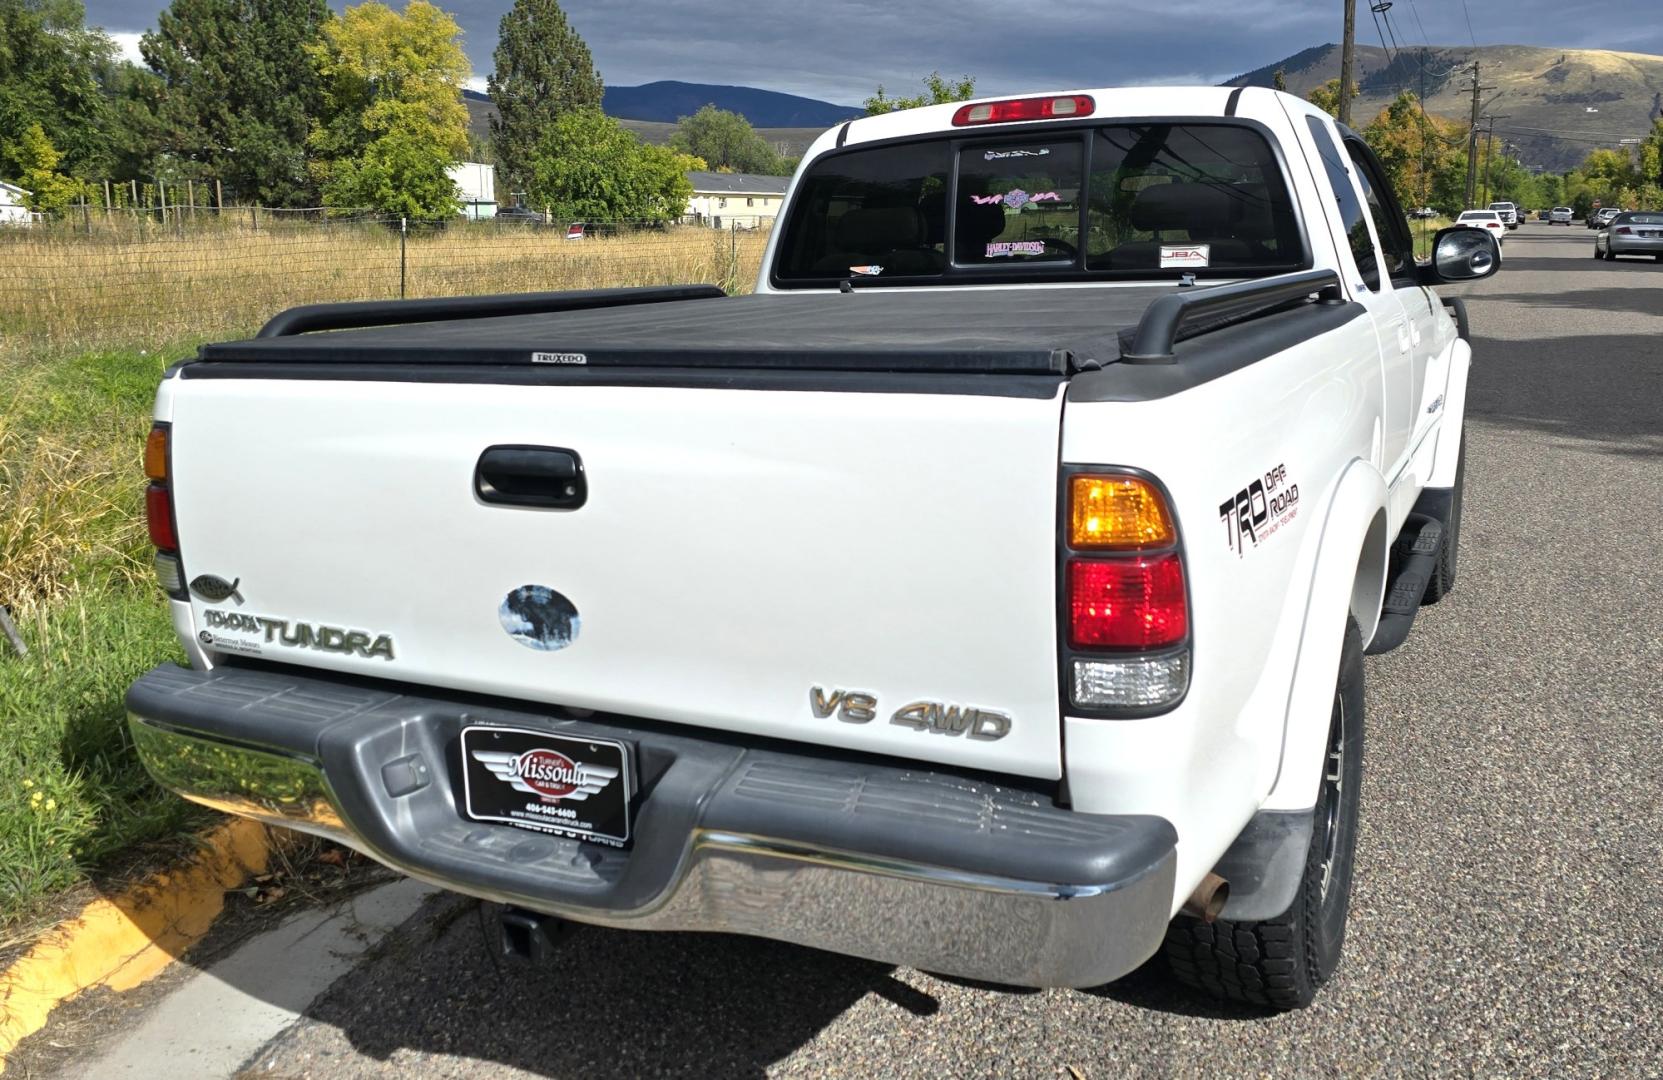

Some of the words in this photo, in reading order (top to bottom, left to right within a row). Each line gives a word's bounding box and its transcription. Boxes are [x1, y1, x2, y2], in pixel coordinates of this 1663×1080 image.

[985, 241, 1045, 257] HARLEY-DAVIDSON
[537, 354, 583, 363] TRUXEDO
[1265, 463, 1287, 494] OFF
[1219, 478, 1269, 558] TRD
[1270, 484, 1300, 520] ROAD
[204, 609, 262, 633] TOYOTA
[260, 619, 396, 660] TUNDRA
[810, 686, 877, 724] V8
[889, 701, 1012, 741] 4WD
[509, 755, 588, 786] Missoula
